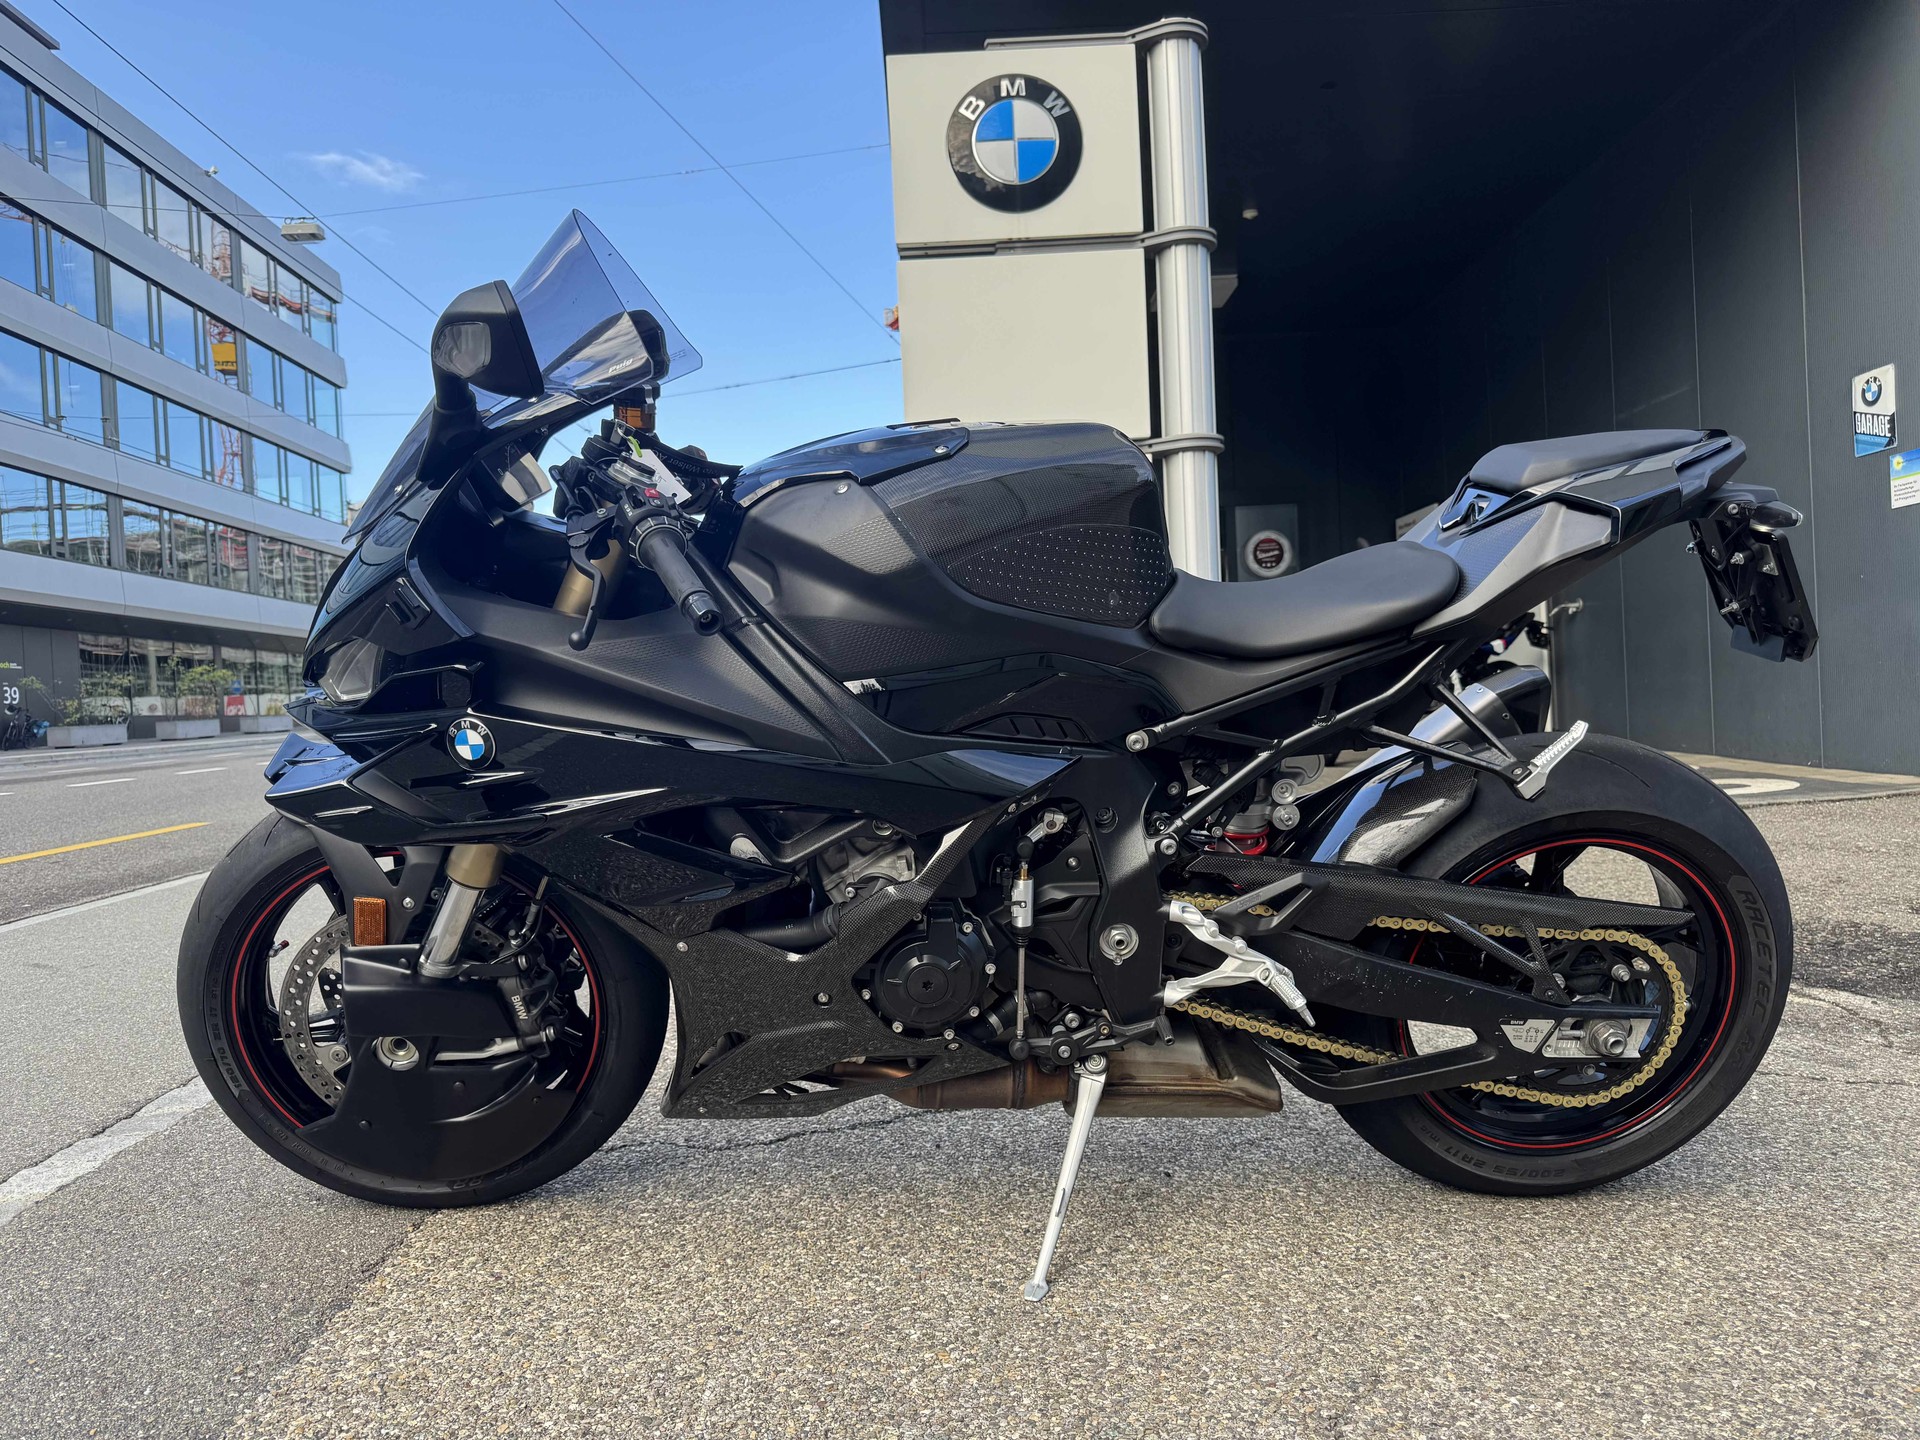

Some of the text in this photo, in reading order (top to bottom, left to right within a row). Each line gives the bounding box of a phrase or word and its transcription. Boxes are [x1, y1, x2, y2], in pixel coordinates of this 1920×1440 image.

[958, 77, 1072, 122] BMW
[1855, 412, 1892, 437] GARAGE
[2, 686, 20, 705] 39
[448, 720, 488, 738] BMW
[1735, 888, 1774, 1024] RACETEC
[511, 994, 529, 1020] BMW
[216, 1046, 243, 1090] 120/70
[1492, 1165, 1566, 1179] 200/55
